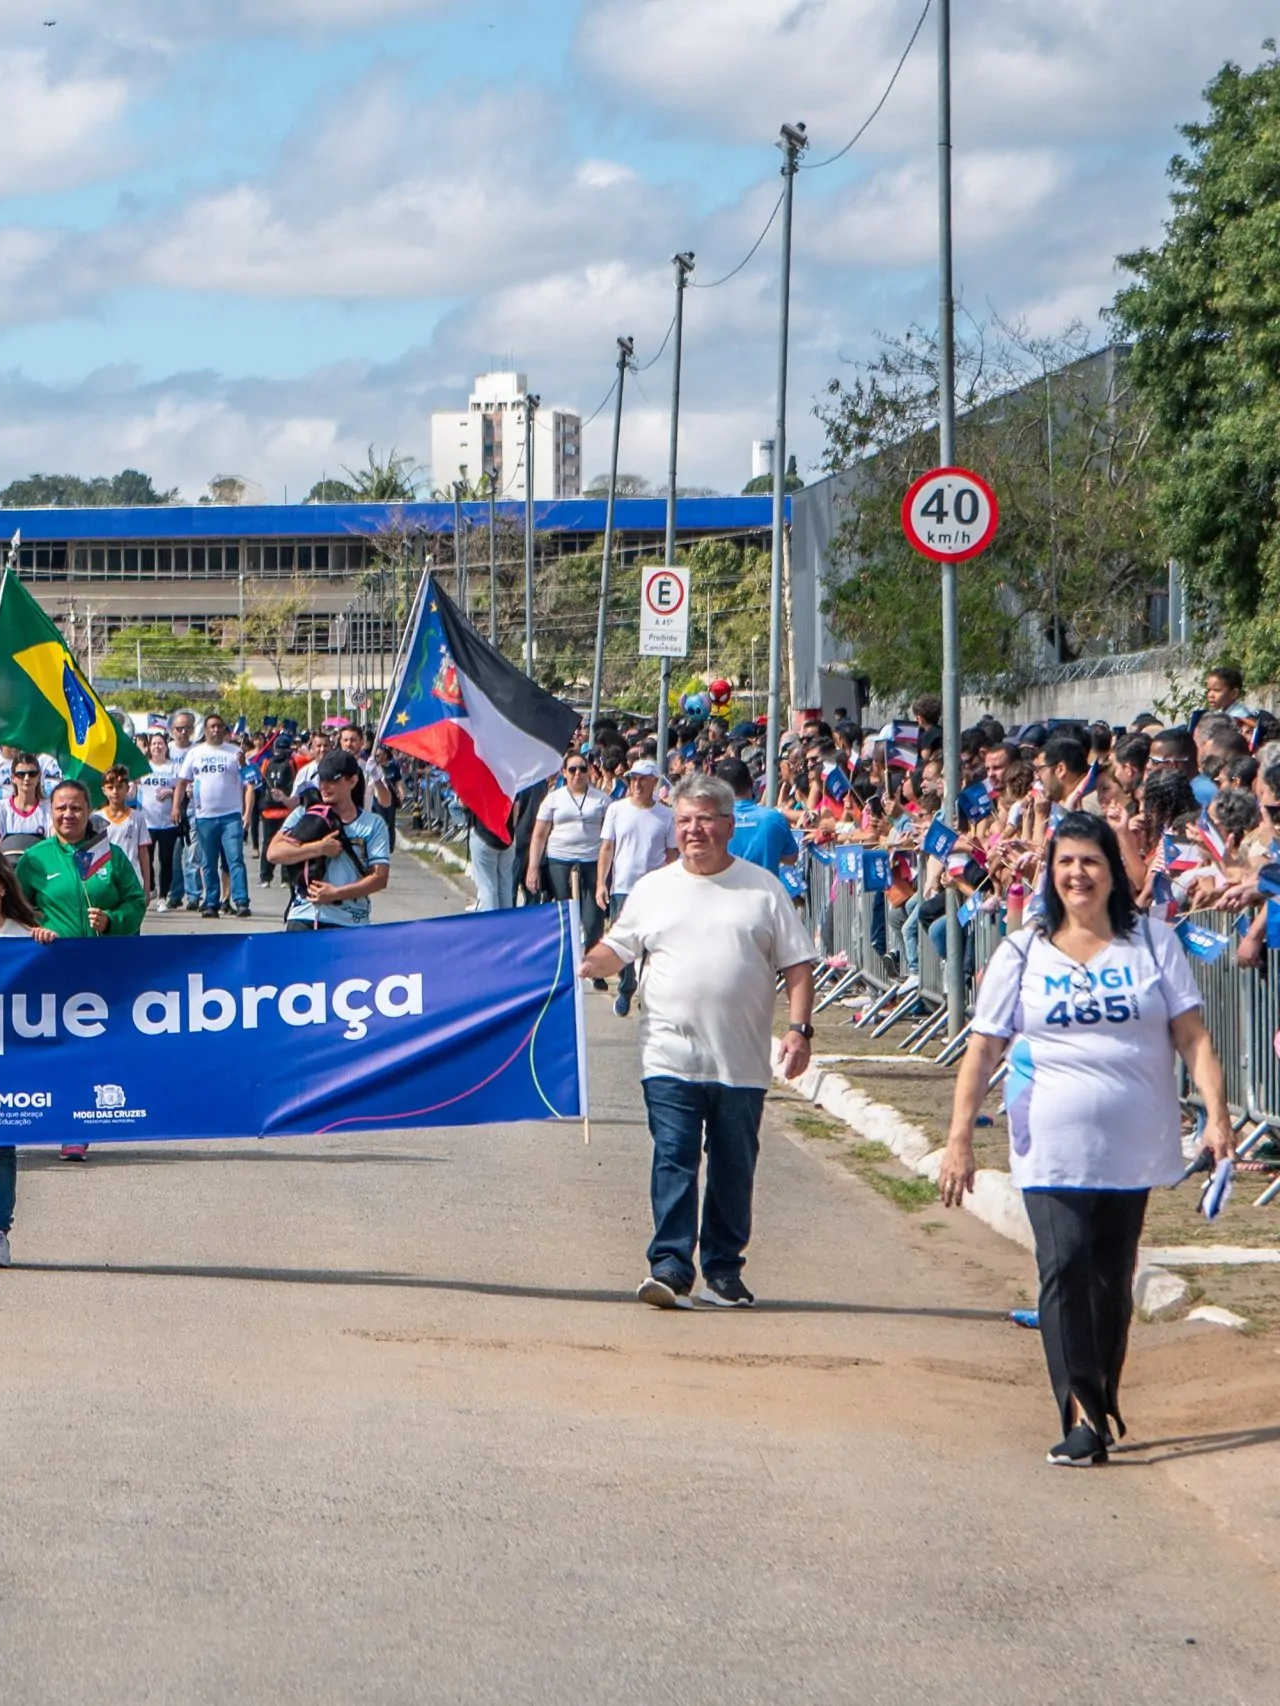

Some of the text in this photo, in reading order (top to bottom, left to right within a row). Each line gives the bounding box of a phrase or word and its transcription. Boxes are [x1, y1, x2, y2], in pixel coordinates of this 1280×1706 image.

[920, 488, 980, 526] 40
[927, 530, 971, 544] km/h
[658, 580, 671, 605] E
[648, 633, 678, 642] Proibido
[201, 756, 227, 764] MOGI
[201, 764, 225, 774] 465
[144, 778, 166, 786] 465
[132, 973, 423, 1040] abraça
[1045, 995, 1131, 1028] 465
[6, 1111, 19, 1119] que
[73, 1109, 147, 1119] MOGI DAS CRUZES
